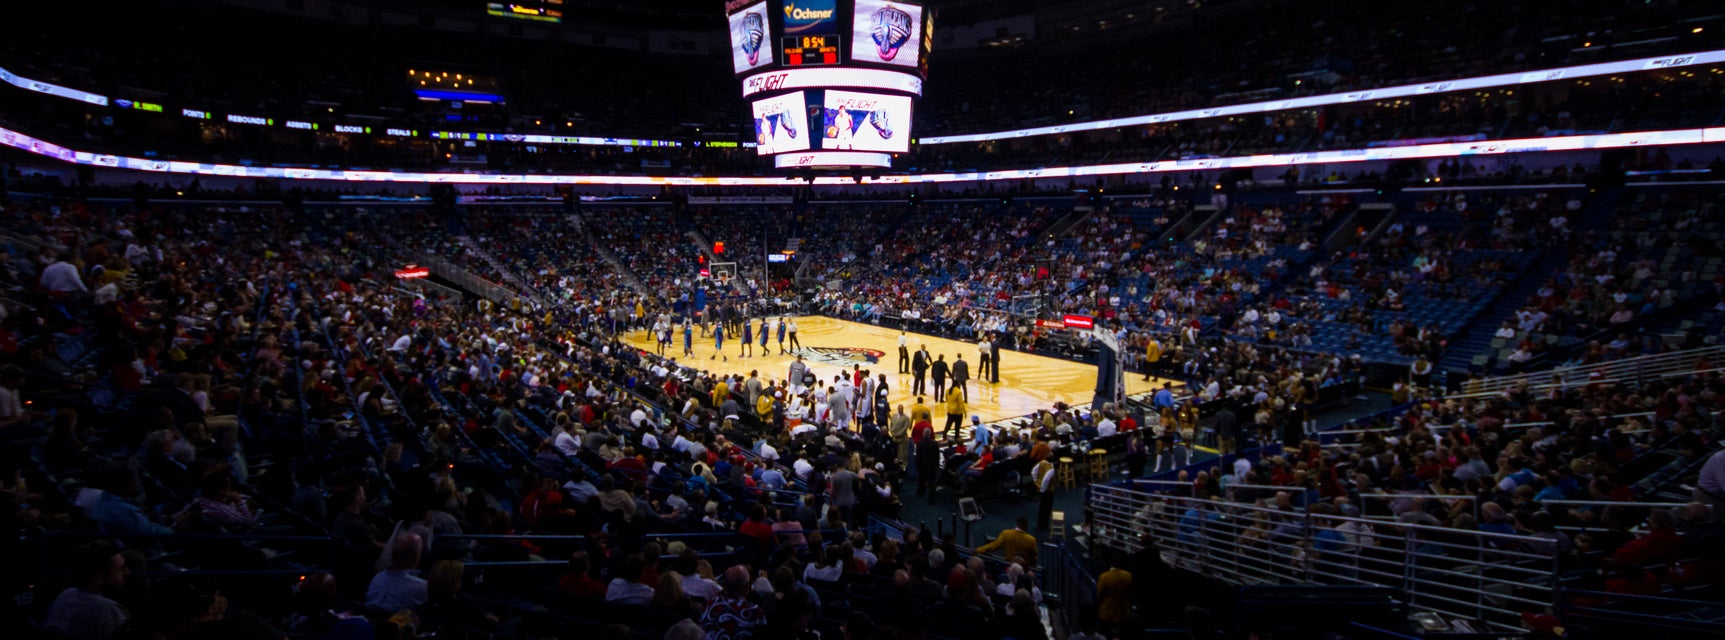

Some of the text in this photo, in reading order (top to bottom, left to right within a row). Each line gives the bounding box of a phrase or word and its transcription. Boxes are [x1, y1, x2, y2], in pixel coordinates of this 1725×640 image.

[793, 8, 833, 19] Ochsner
[1661, 56, 1694, 66] FLIGHT
[755, 73, 789, 92] FLIGHT
[182, 109, 205, 119] POINTS
[227, 114, 266, 125] REBOUNDS
[285, 120, 312, 130] ASSISTS
[335, 124, 363, 133] BLOCKS
[386, 128, 411, 137] STEALS
